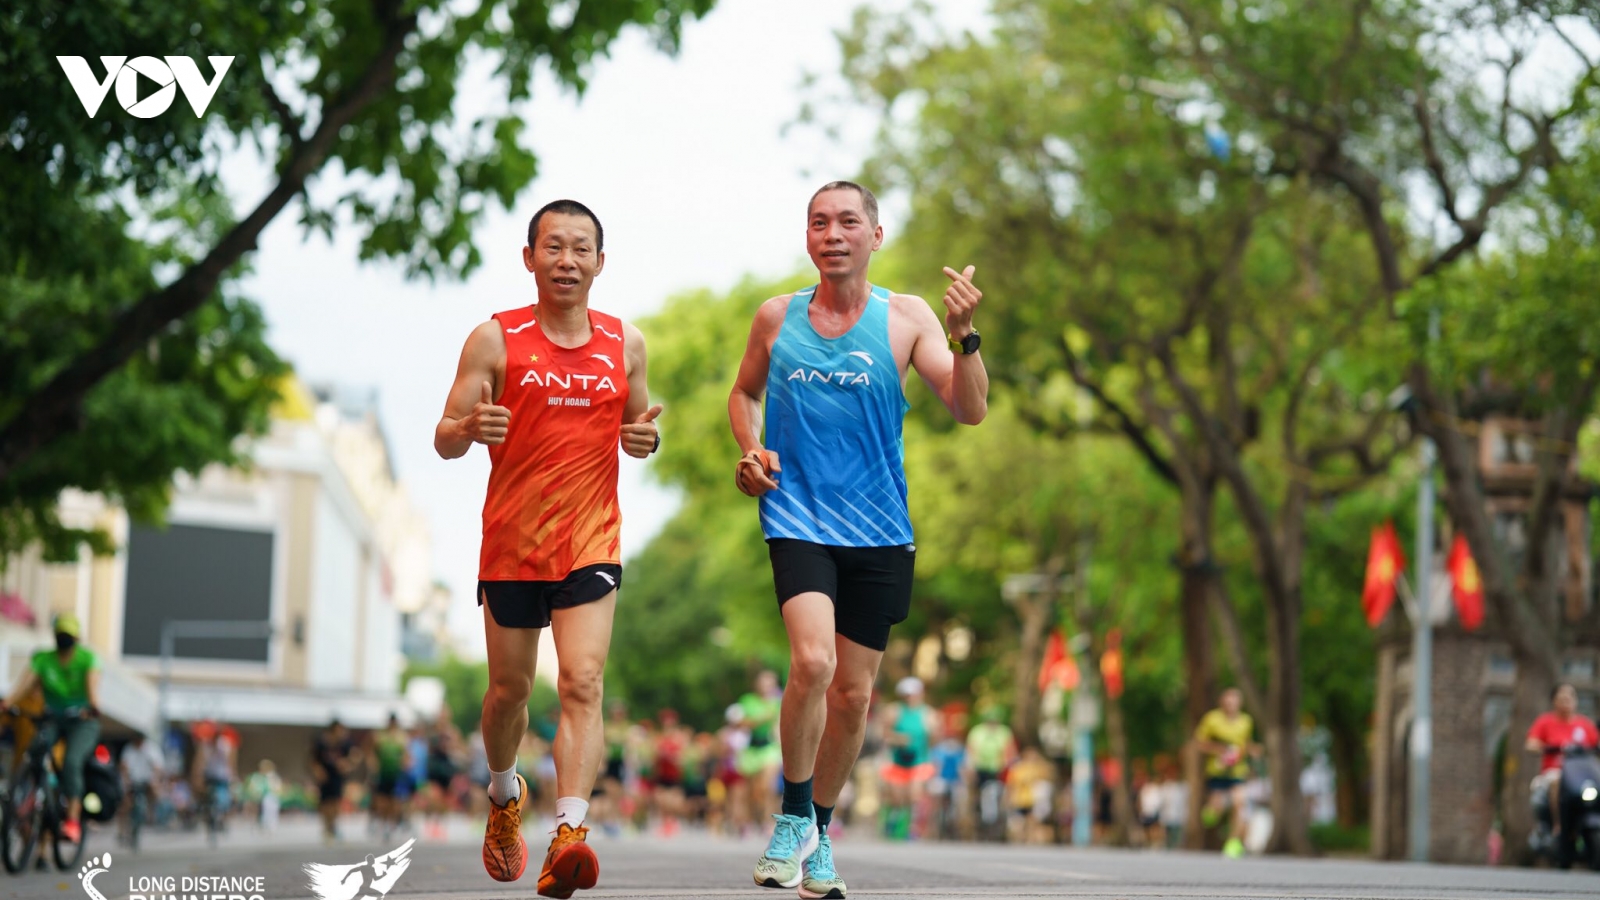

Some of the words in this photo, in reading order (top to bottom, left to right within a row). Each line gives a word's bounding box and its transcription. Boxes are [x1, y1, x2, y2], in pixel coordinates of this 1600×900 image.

[520, 370, 617, 393] ANTA
[787, 368, 870, 386] ANTA
[547, 396, 563, 406] HUY
[564, 397, 591, 407] HOANG
